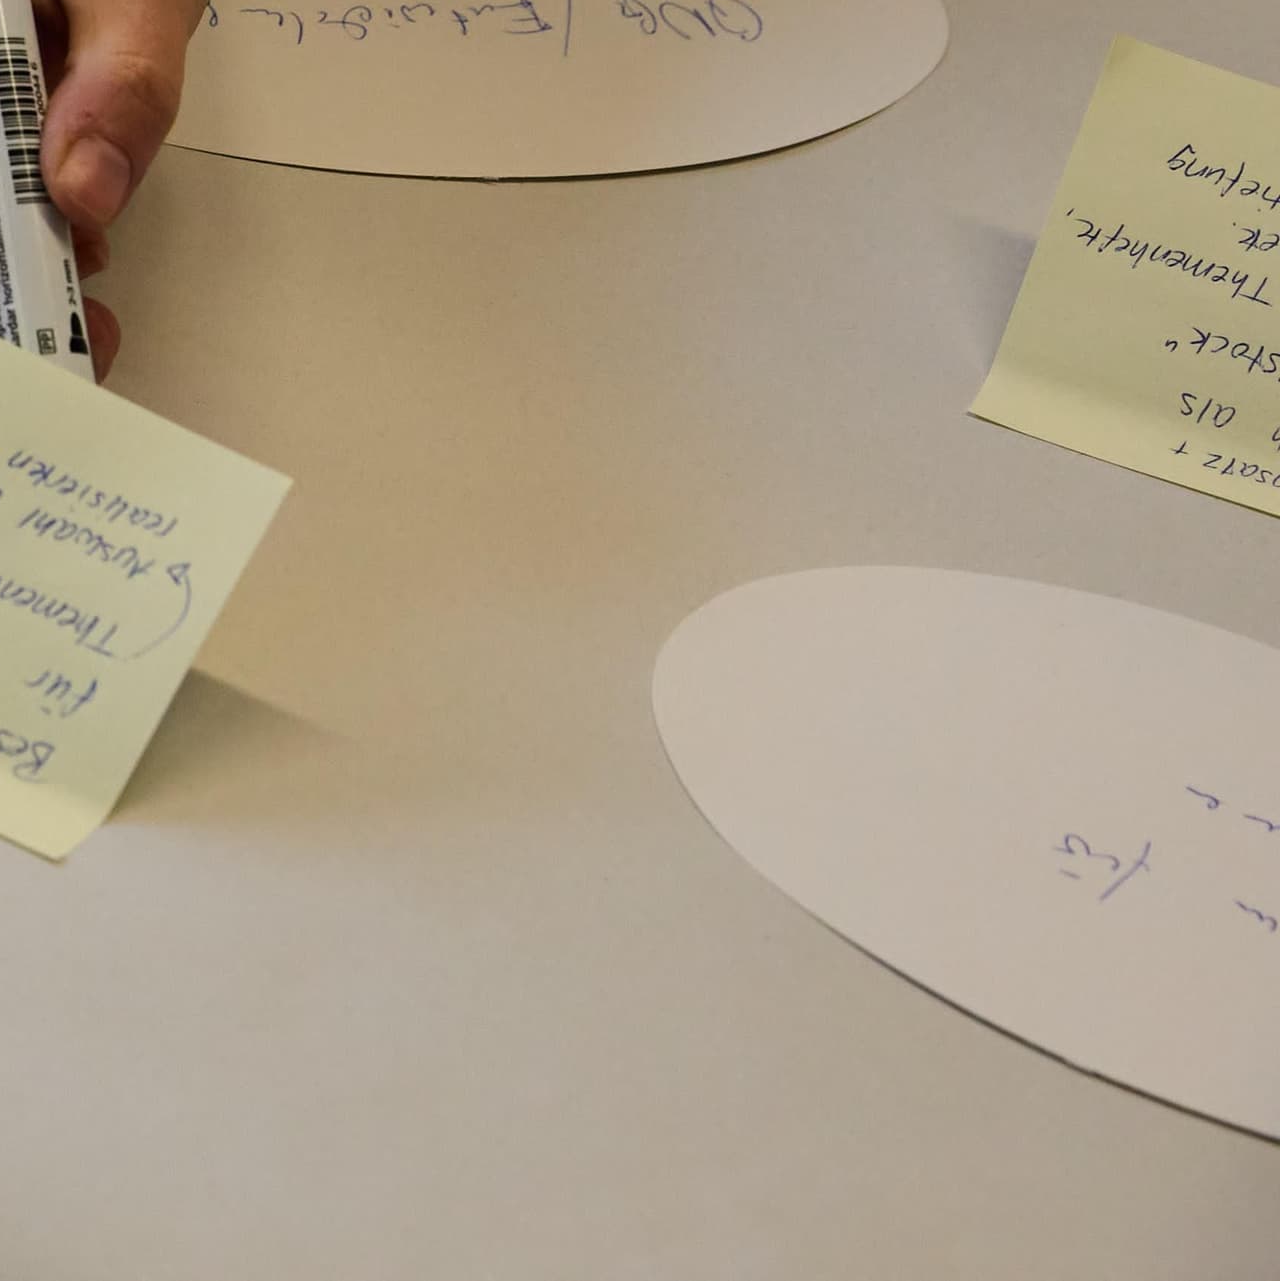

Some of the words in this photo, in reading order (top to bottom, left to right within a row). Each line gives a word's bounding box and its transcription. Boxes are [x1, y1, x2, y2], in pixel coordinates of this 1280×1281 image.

[1166, 143, 1280, 211] tiefung
[1164, 326, 1280, 374] stock"
[1179, 391, 1237, 429] als
[6, 449, 179, 537] realisierten
[17, 507, 155, 580] Auswahl
[26, 670, 99, 718] für
